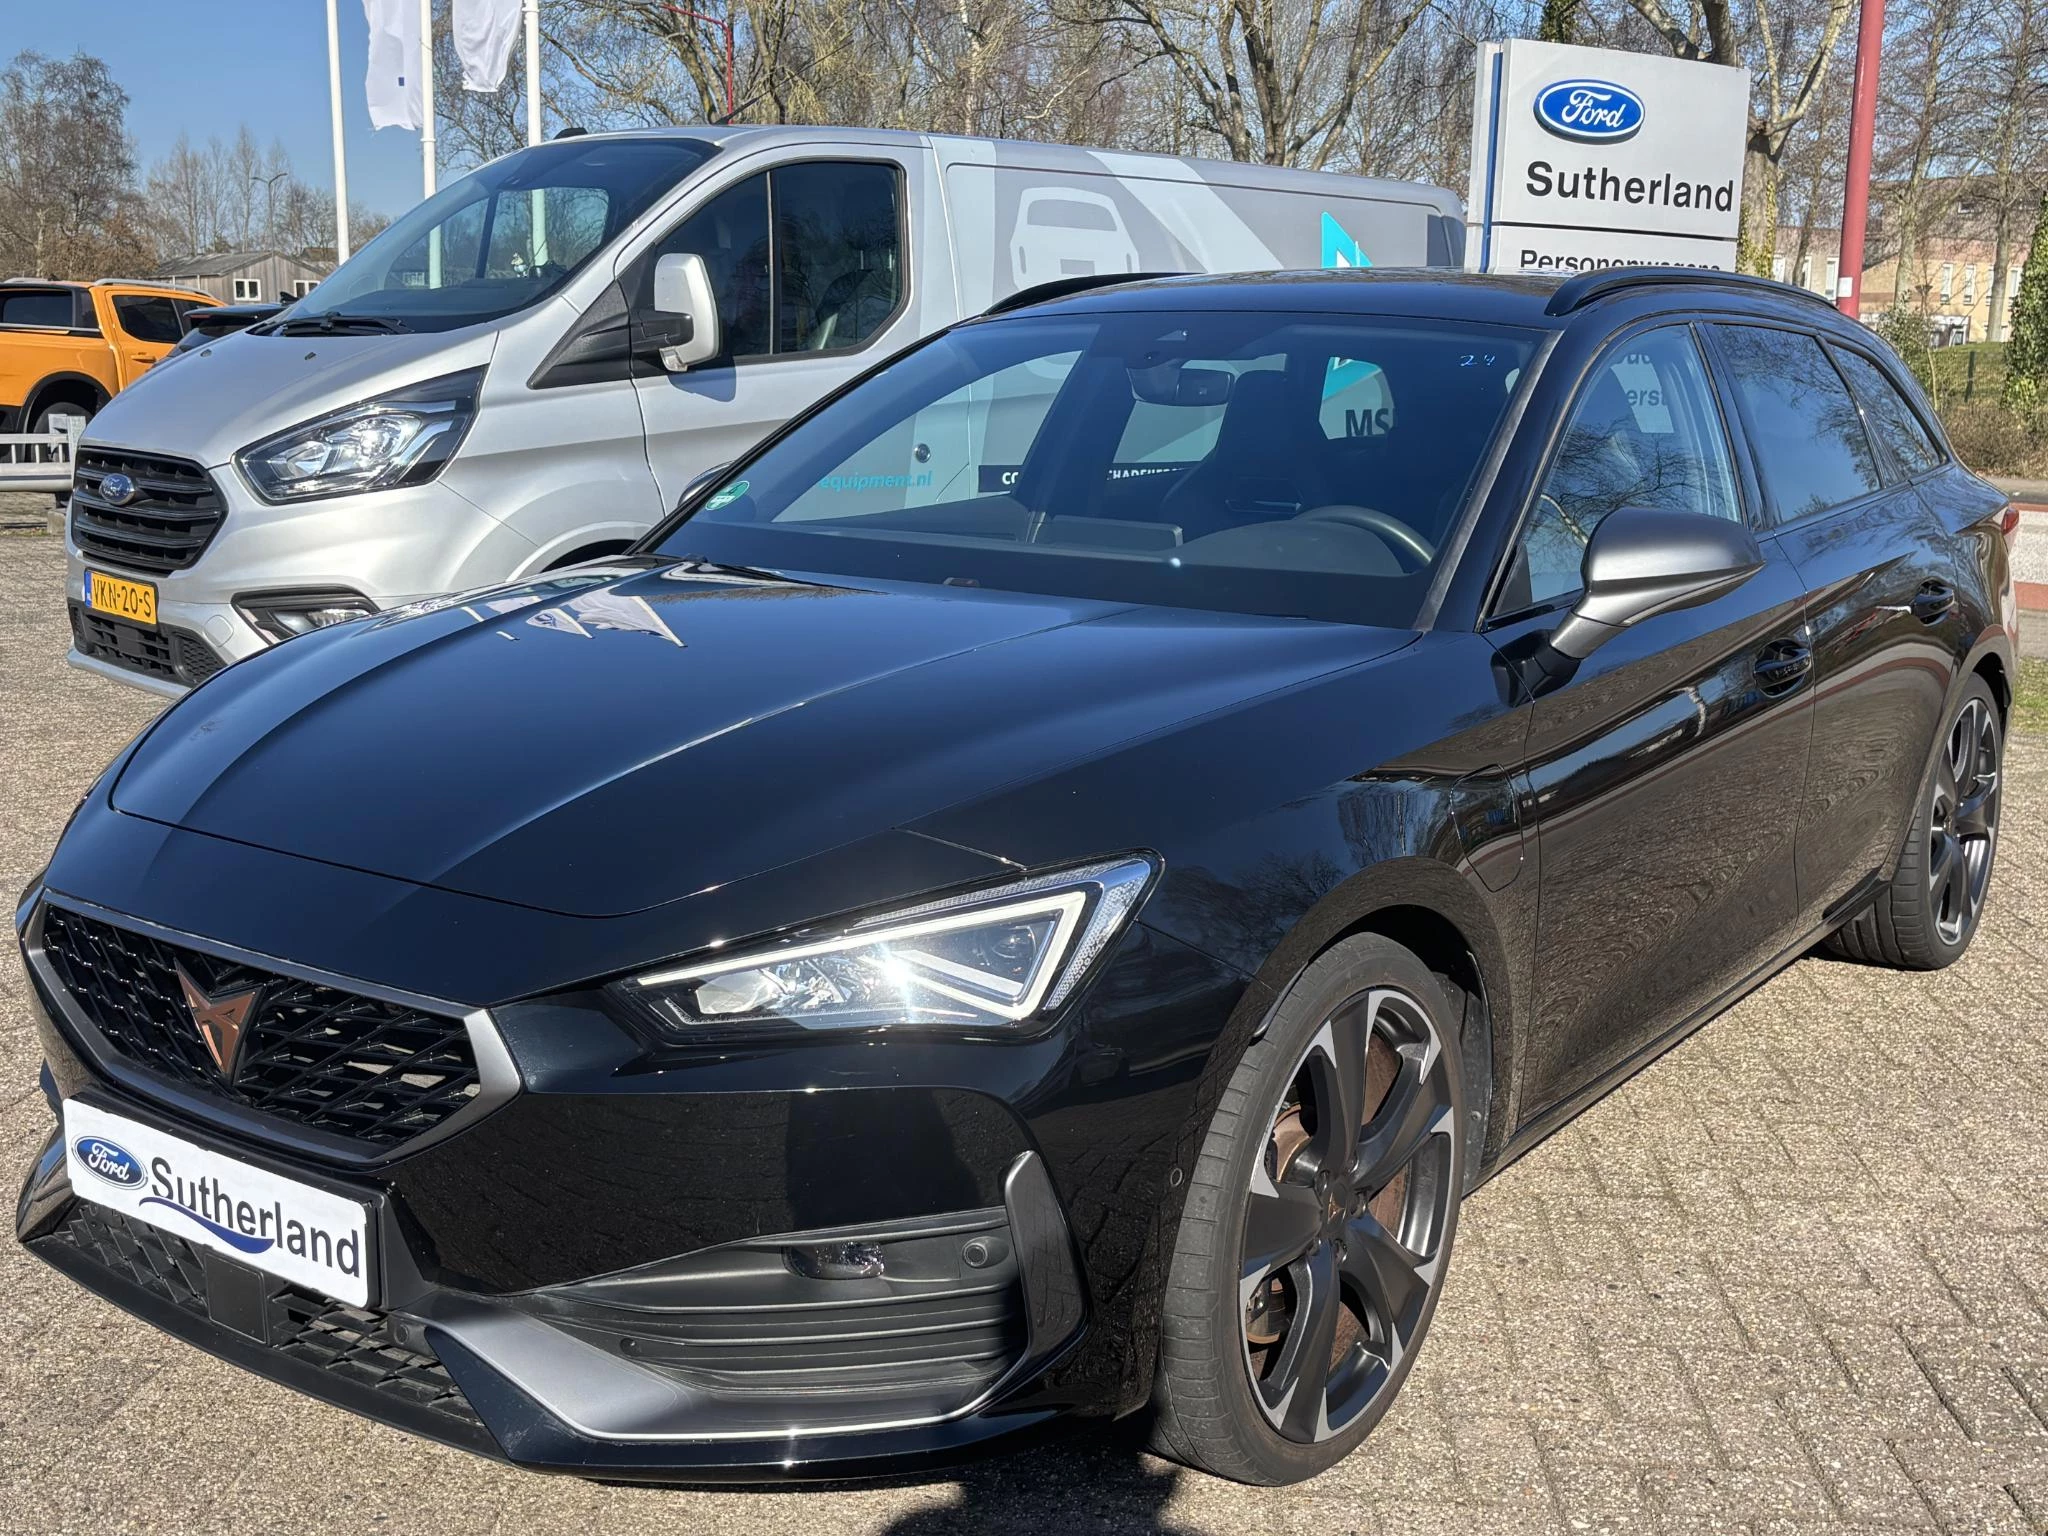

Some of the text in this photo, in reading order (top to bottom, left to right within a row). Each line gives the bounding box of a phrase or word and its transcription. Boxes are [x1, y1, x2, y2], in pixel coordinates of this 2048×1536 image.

[1561, 89, 1624, 128] Ford
[1526, 160, 1734, 212] Sutherland
[93, 578, 152, 618] VKN-20-S
[88, 1142, 130, 1181] Ford
[151, 1156, 360, 1278] Sutherland
